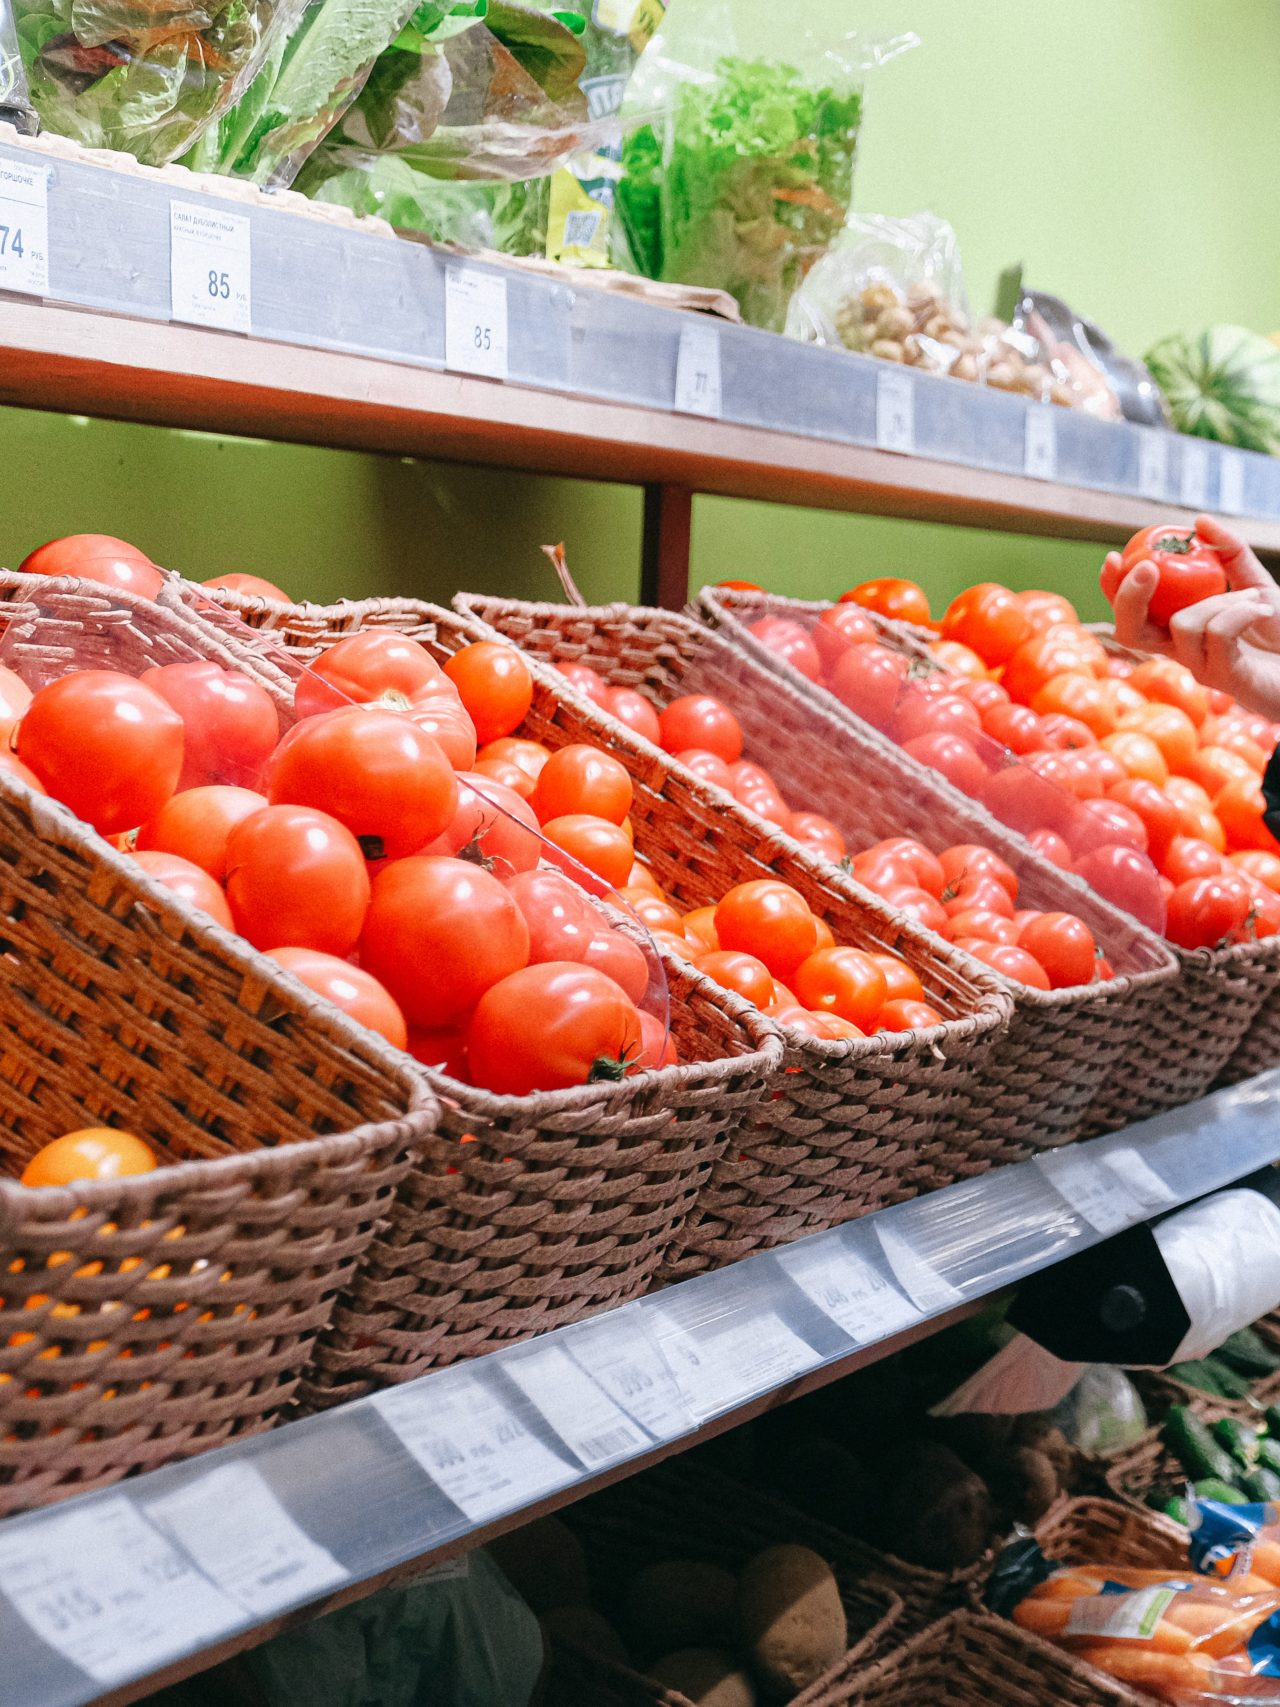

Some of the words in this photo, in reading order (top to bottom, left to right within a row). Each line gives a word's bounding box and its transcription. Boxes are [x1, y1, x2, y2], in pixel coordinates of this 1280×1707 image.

[0, 224, 24, 258] 74
[208, 269, 230, 299] 85
[474, 325, 492, 350] 85
